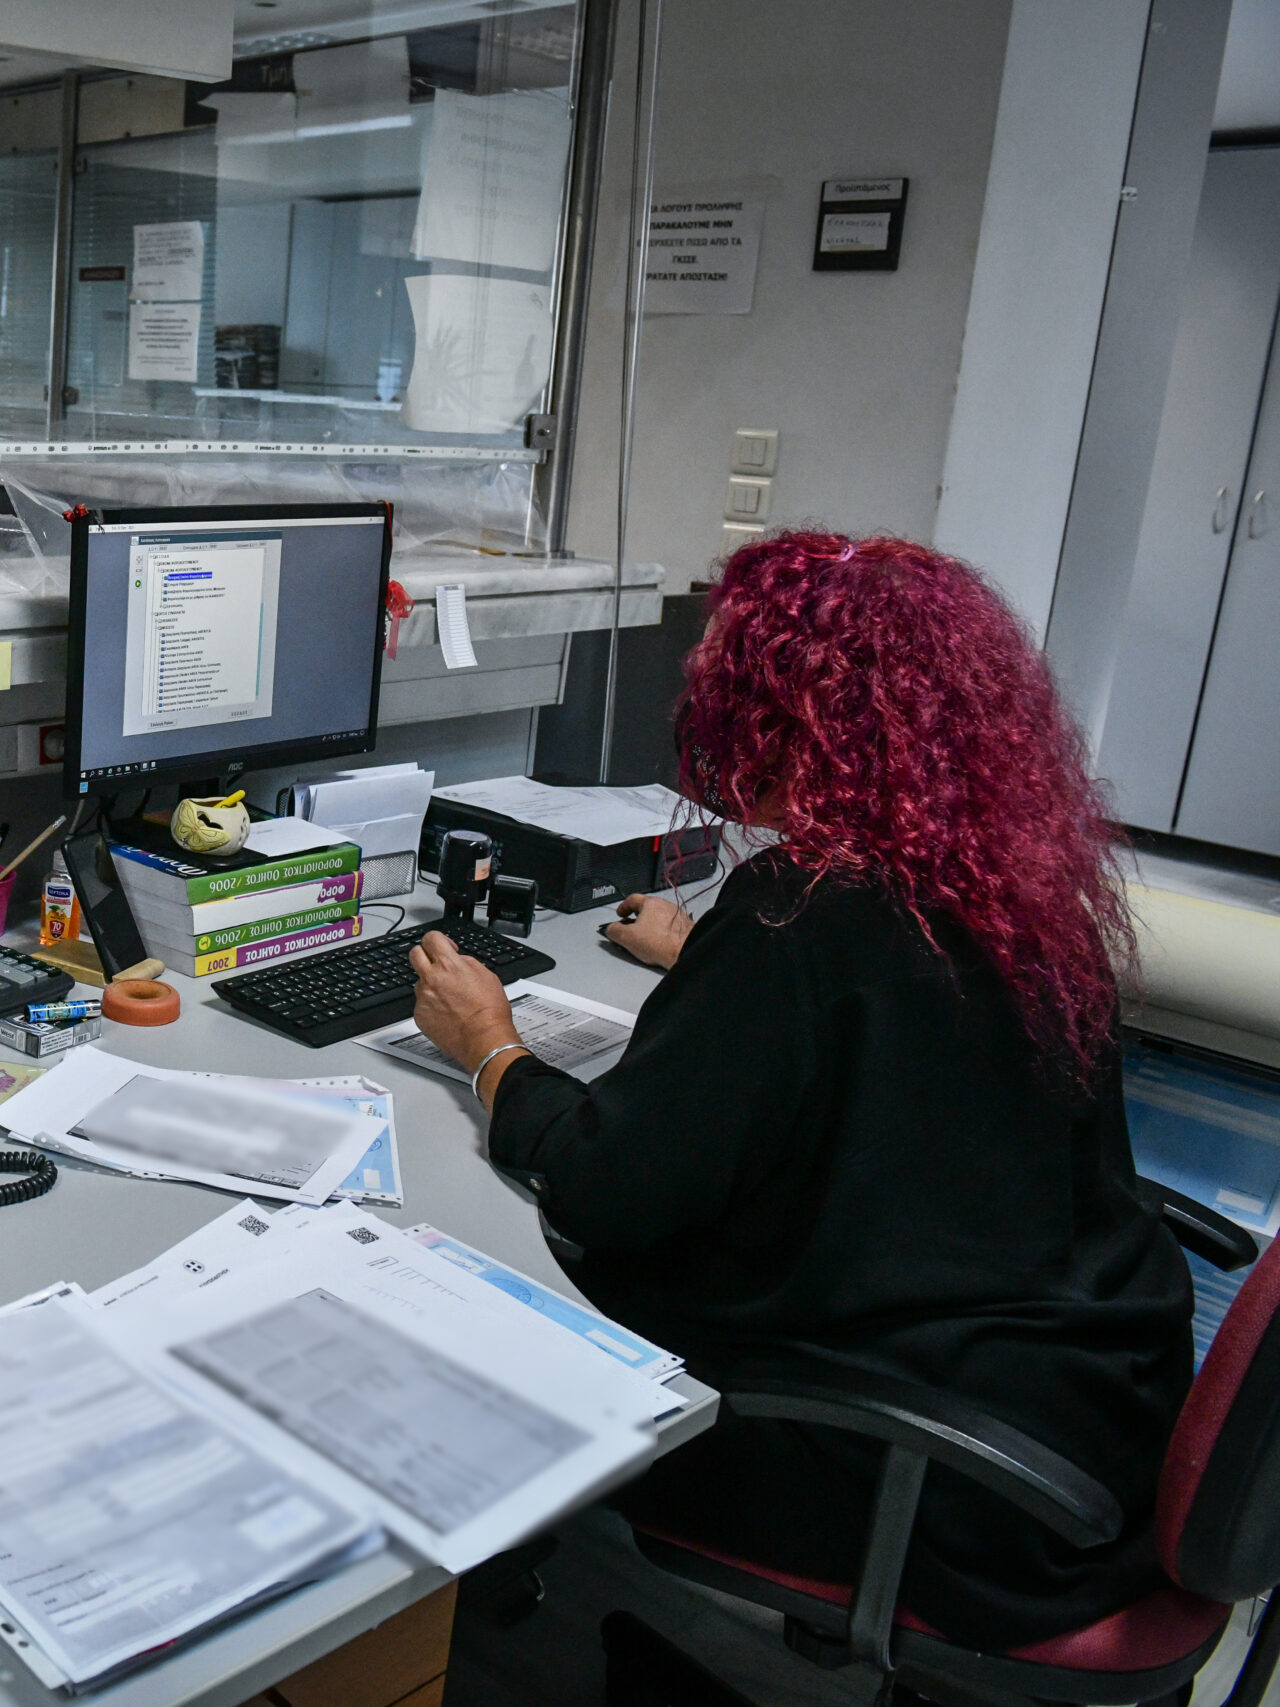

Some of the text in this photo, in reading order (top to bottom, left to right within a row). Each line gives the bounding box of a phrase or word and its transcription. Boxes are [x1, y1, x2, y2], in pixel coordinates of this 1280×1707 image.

[712, 220, 734, 229] ΜΗΝ
[709, 237, 729, 246] ΑΠΟ
[730, 237, 742, 246] ΤΑ
[228, 762, 244, 771] AOC
[283, 857, 343, 879] ΦΟΡΟΛΟΓΙΚΟΣ
[245, 869, 280, 886] ΟΔΗΓΟΣ
[285, 906, 342, 929] ΦΟΡΟΛΟΓΙΚΟΣ
[248, 920, 283, 938] ΟΔΗΓΟΣ
[207, 927, 346, 972] ΦΟΡΟΛΟΓΙΚΟΣ ΟΔΗΓΟΣ 2007
[0, 1027, 16, 1040] West
